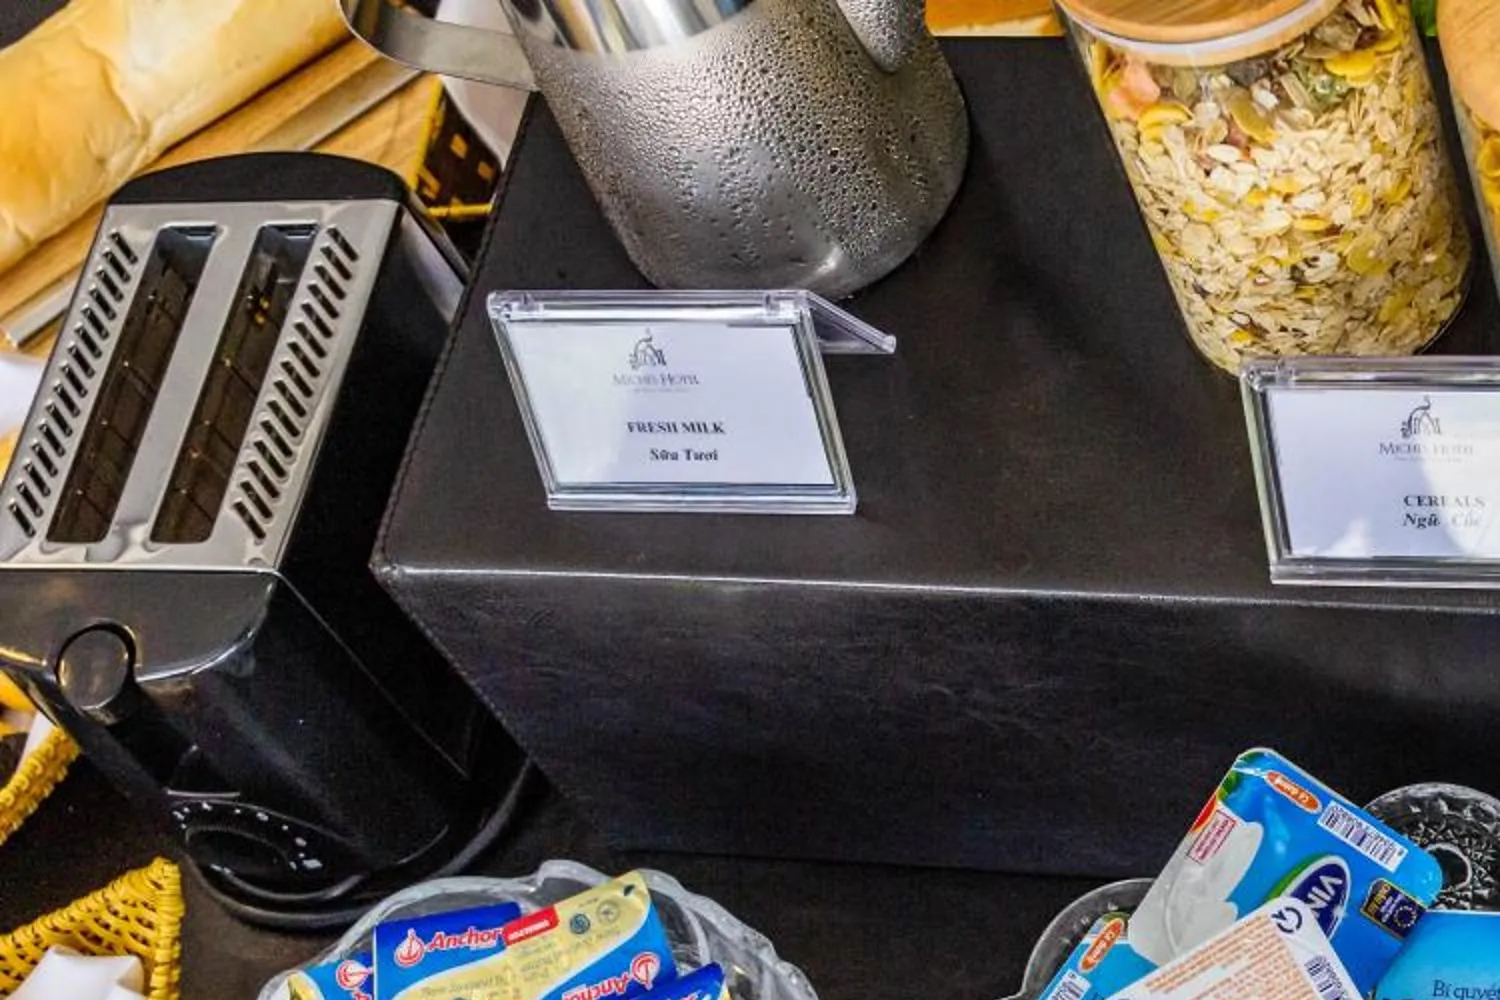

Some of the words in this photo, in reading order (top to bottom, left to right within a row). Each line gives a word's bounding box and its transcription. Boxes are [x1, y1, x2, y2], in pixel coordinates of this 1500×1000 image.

[628, 421, 676, 434] FRESH
[680, 421, 725, 434] MILK
[650, 448, 678, 462] Sữa
[683, 448, 718, 462] Tươi
[1404, 495, 1485, 507] CEREALS
[424, 927, 504, 952] Anchor
[1433, 980, 1452, 997] Bí
